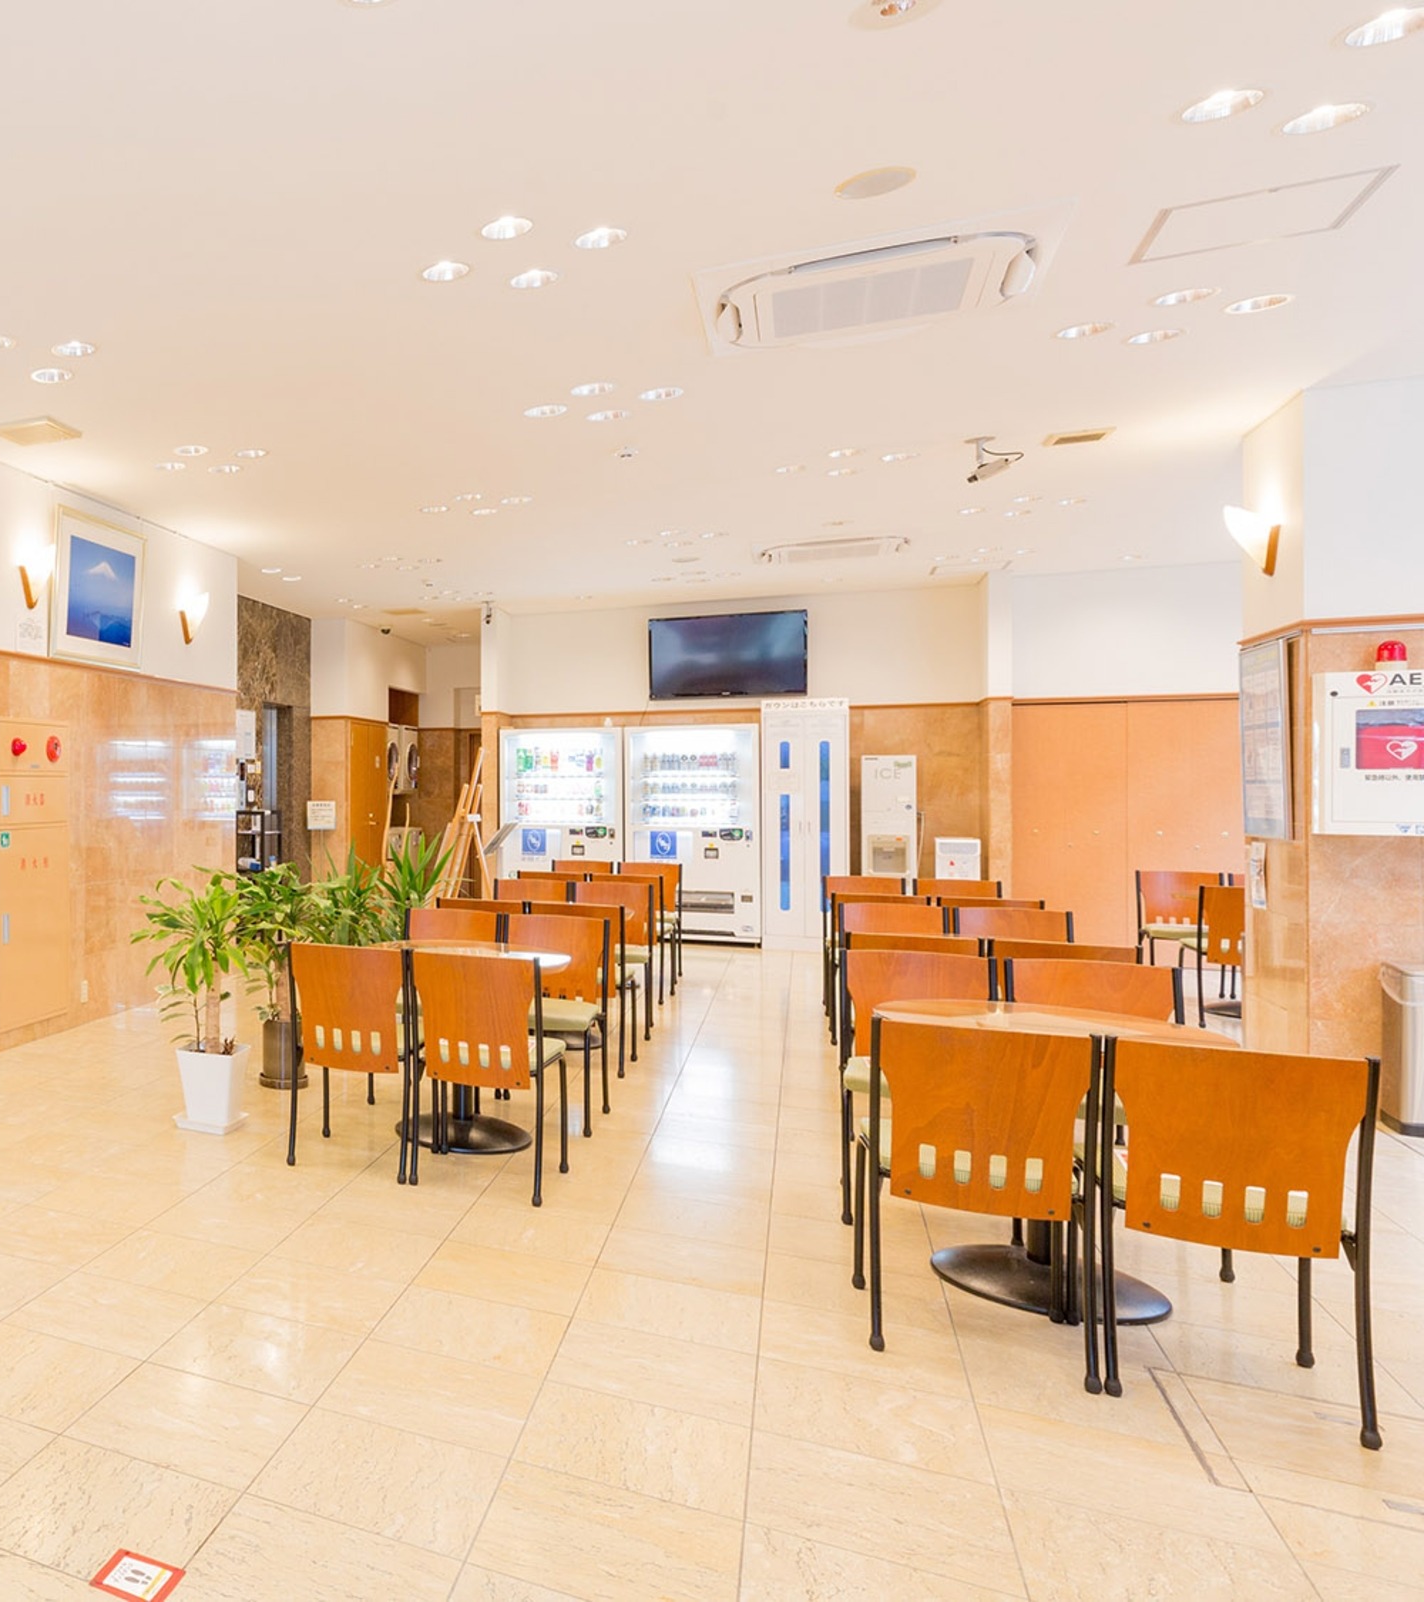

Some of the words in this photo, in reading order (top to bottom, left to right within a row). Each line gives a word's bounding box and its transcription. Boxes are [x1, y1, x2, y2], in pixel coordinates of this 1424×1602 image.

[765, 700, 844, 709] ガウンはこちらです
[874, 767, 901, 780] ICE
